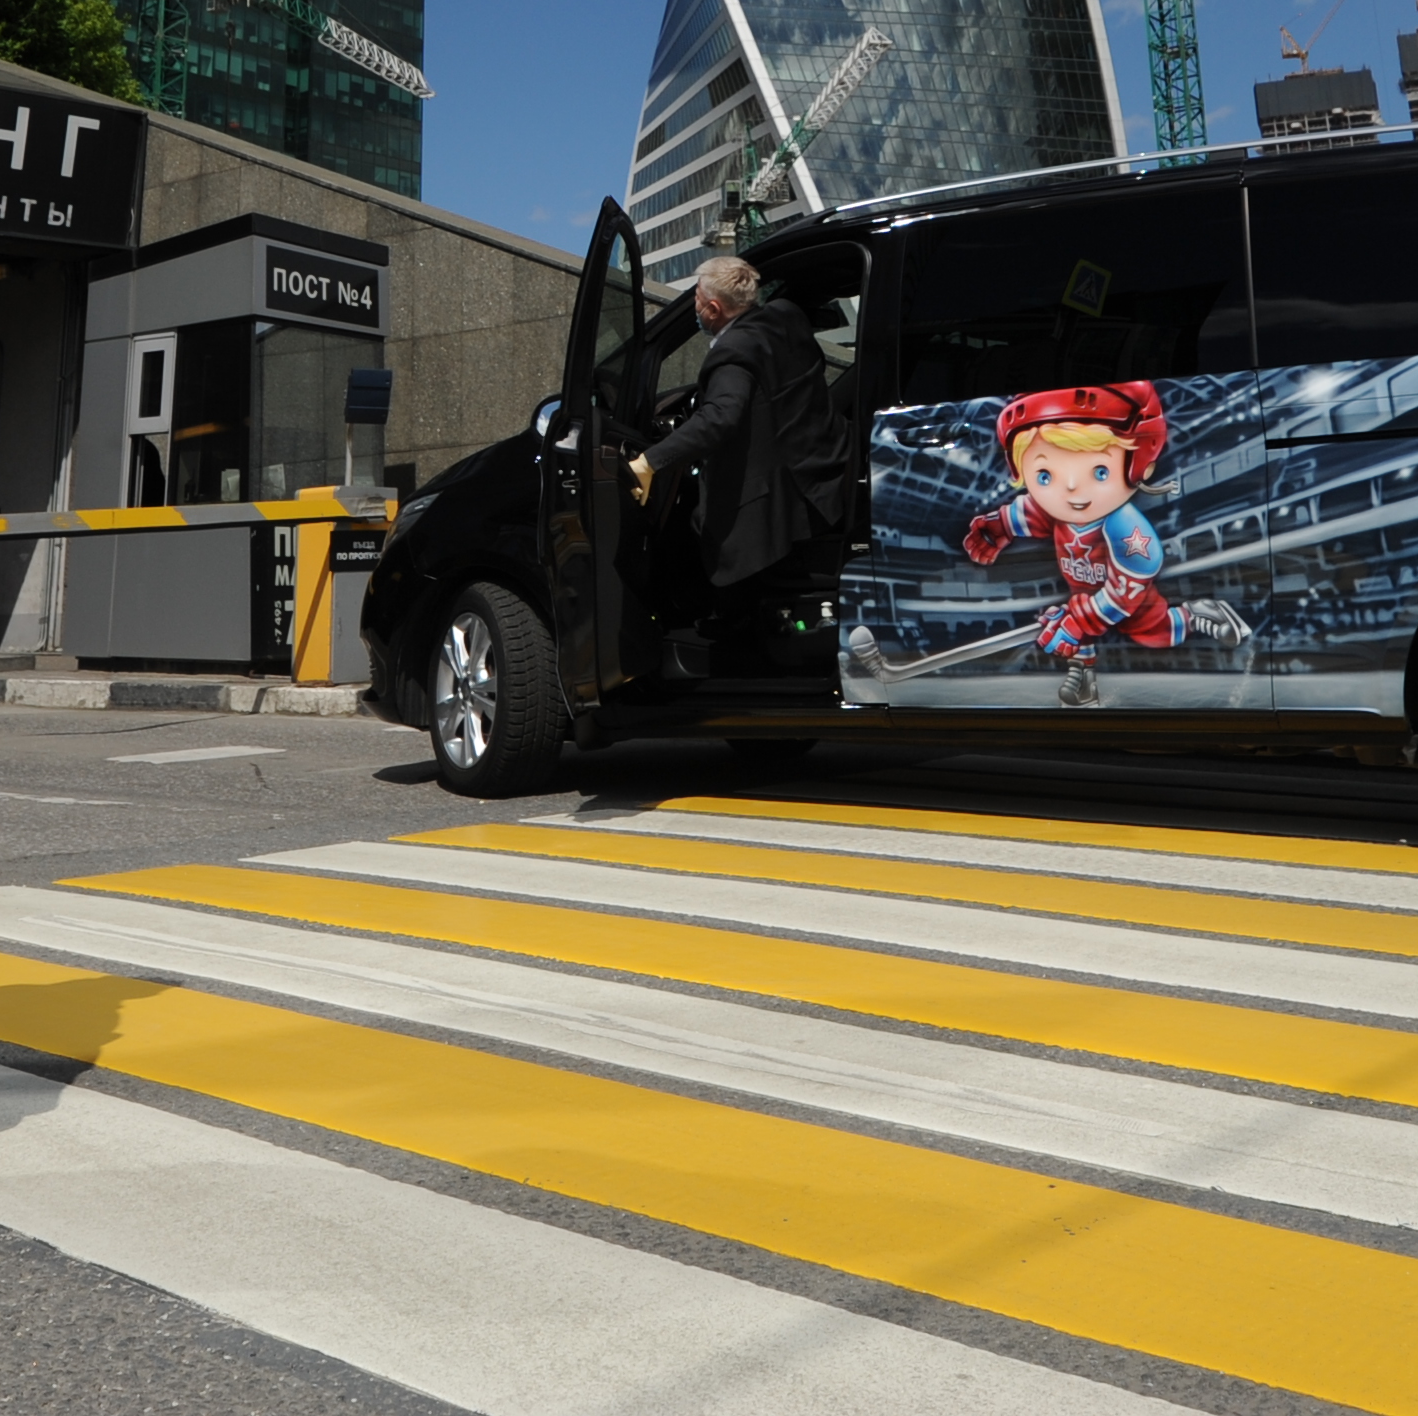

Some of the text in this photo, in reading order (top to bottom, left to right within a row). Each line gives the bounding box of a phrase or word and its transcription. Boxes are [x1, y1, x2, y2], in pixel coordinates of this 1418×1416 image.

[273, 267, 373, 310] ПОСТ №4
[336, 552, 348, 560] ПО
[1116, 575, 1145, 600] 37
